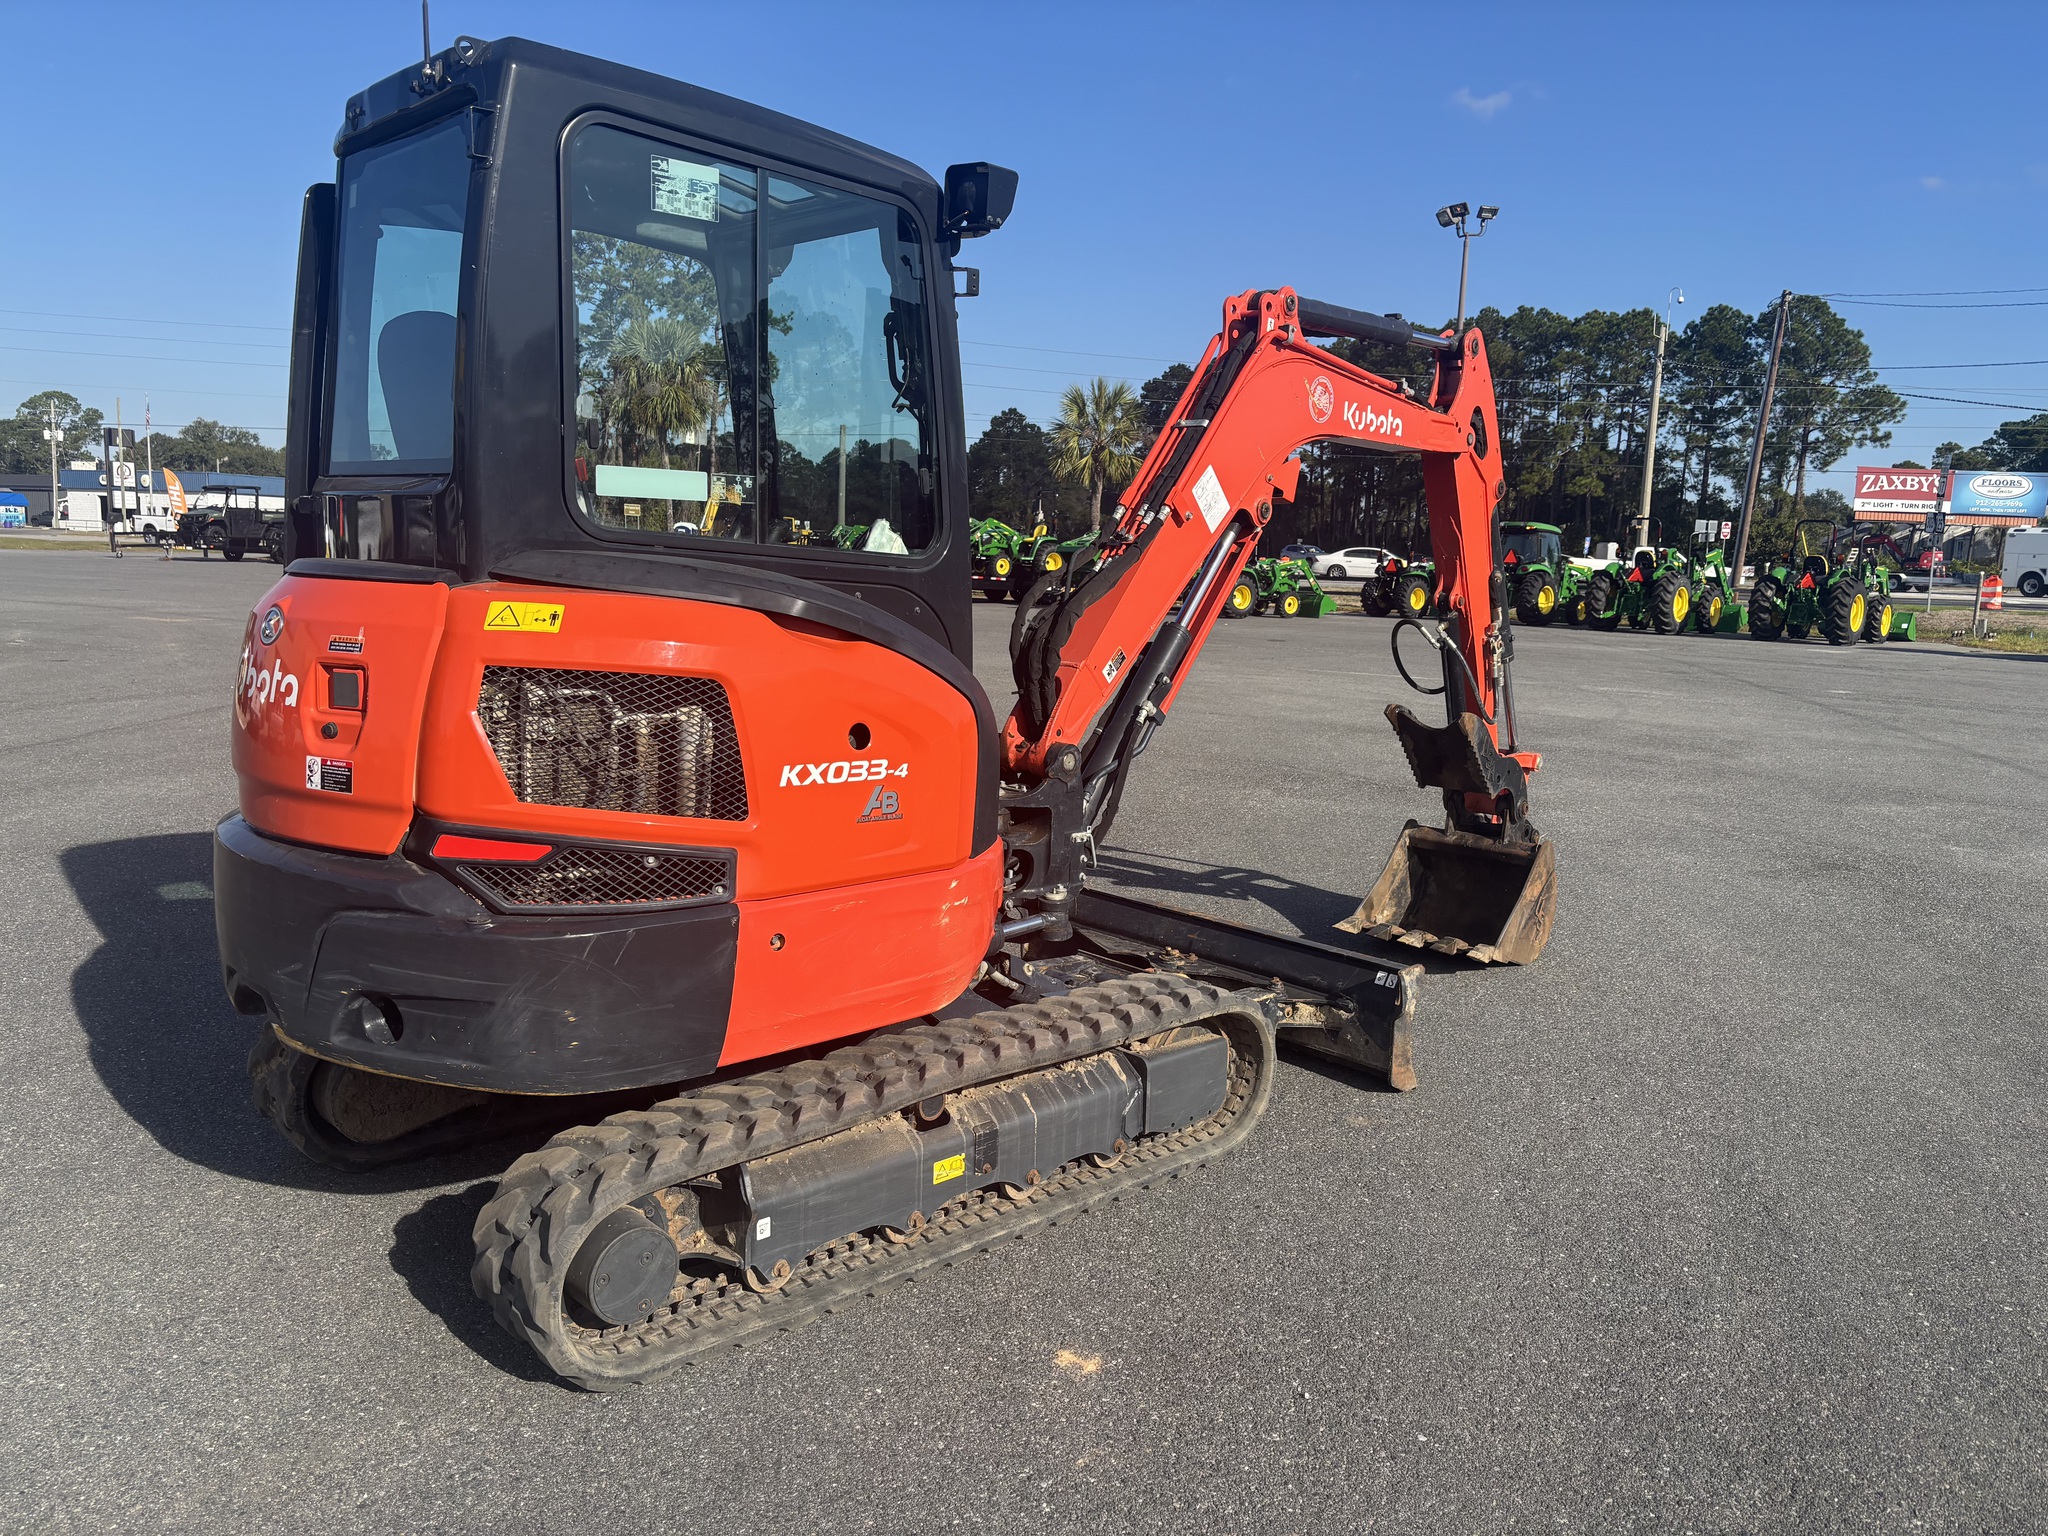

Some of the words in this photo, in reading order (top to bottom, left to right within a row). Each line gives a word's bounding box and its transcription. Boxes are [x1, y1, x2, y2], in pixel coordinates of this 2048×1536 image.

[1343, 401, 1403, 437] Kubota
[1981, 479, 2023, 487] FLOORS
[1975, 499, 2023, 507] 912-265-9696
[239, 653, 299, 708] ubota
[779, 759, 908, 787] KX033-4
[861, 784, 899, 816] AB
